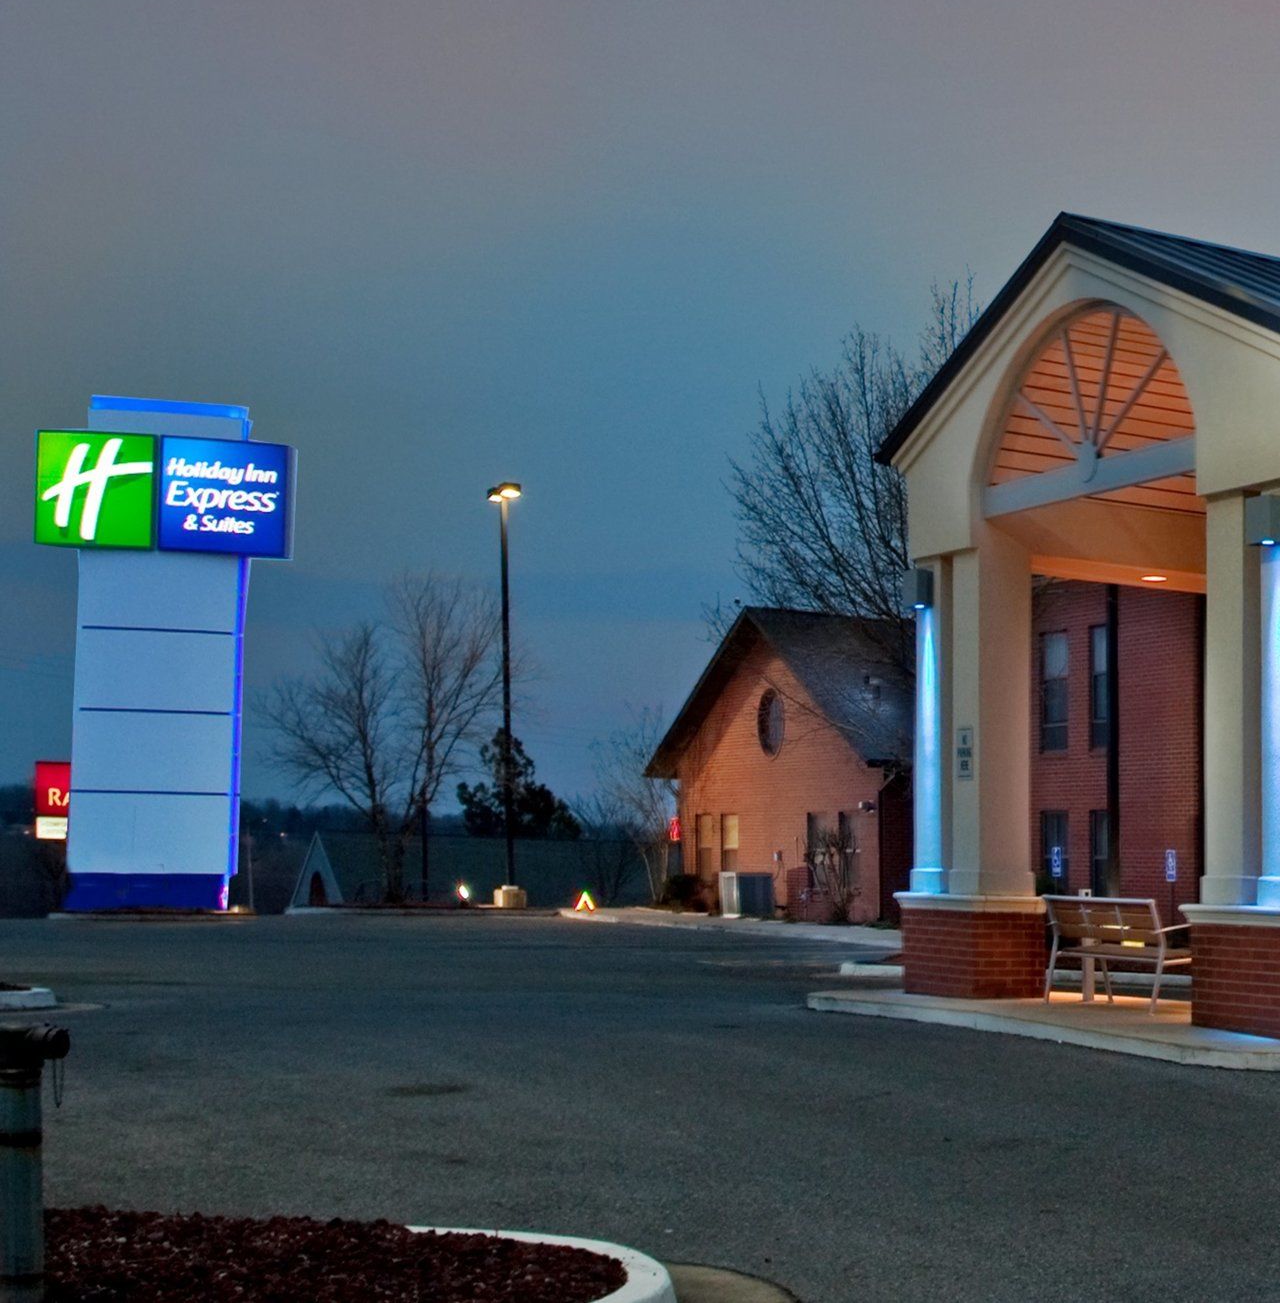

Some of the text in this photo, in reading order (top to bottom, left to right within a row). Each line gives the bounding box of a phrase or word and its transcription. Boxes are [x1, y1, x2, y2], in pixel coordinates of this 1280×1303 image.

[166, 457, 278, 485] Holiday Inn
[165, 480, 276, 514] Express
[183, 514, 255, 535] & Suites
